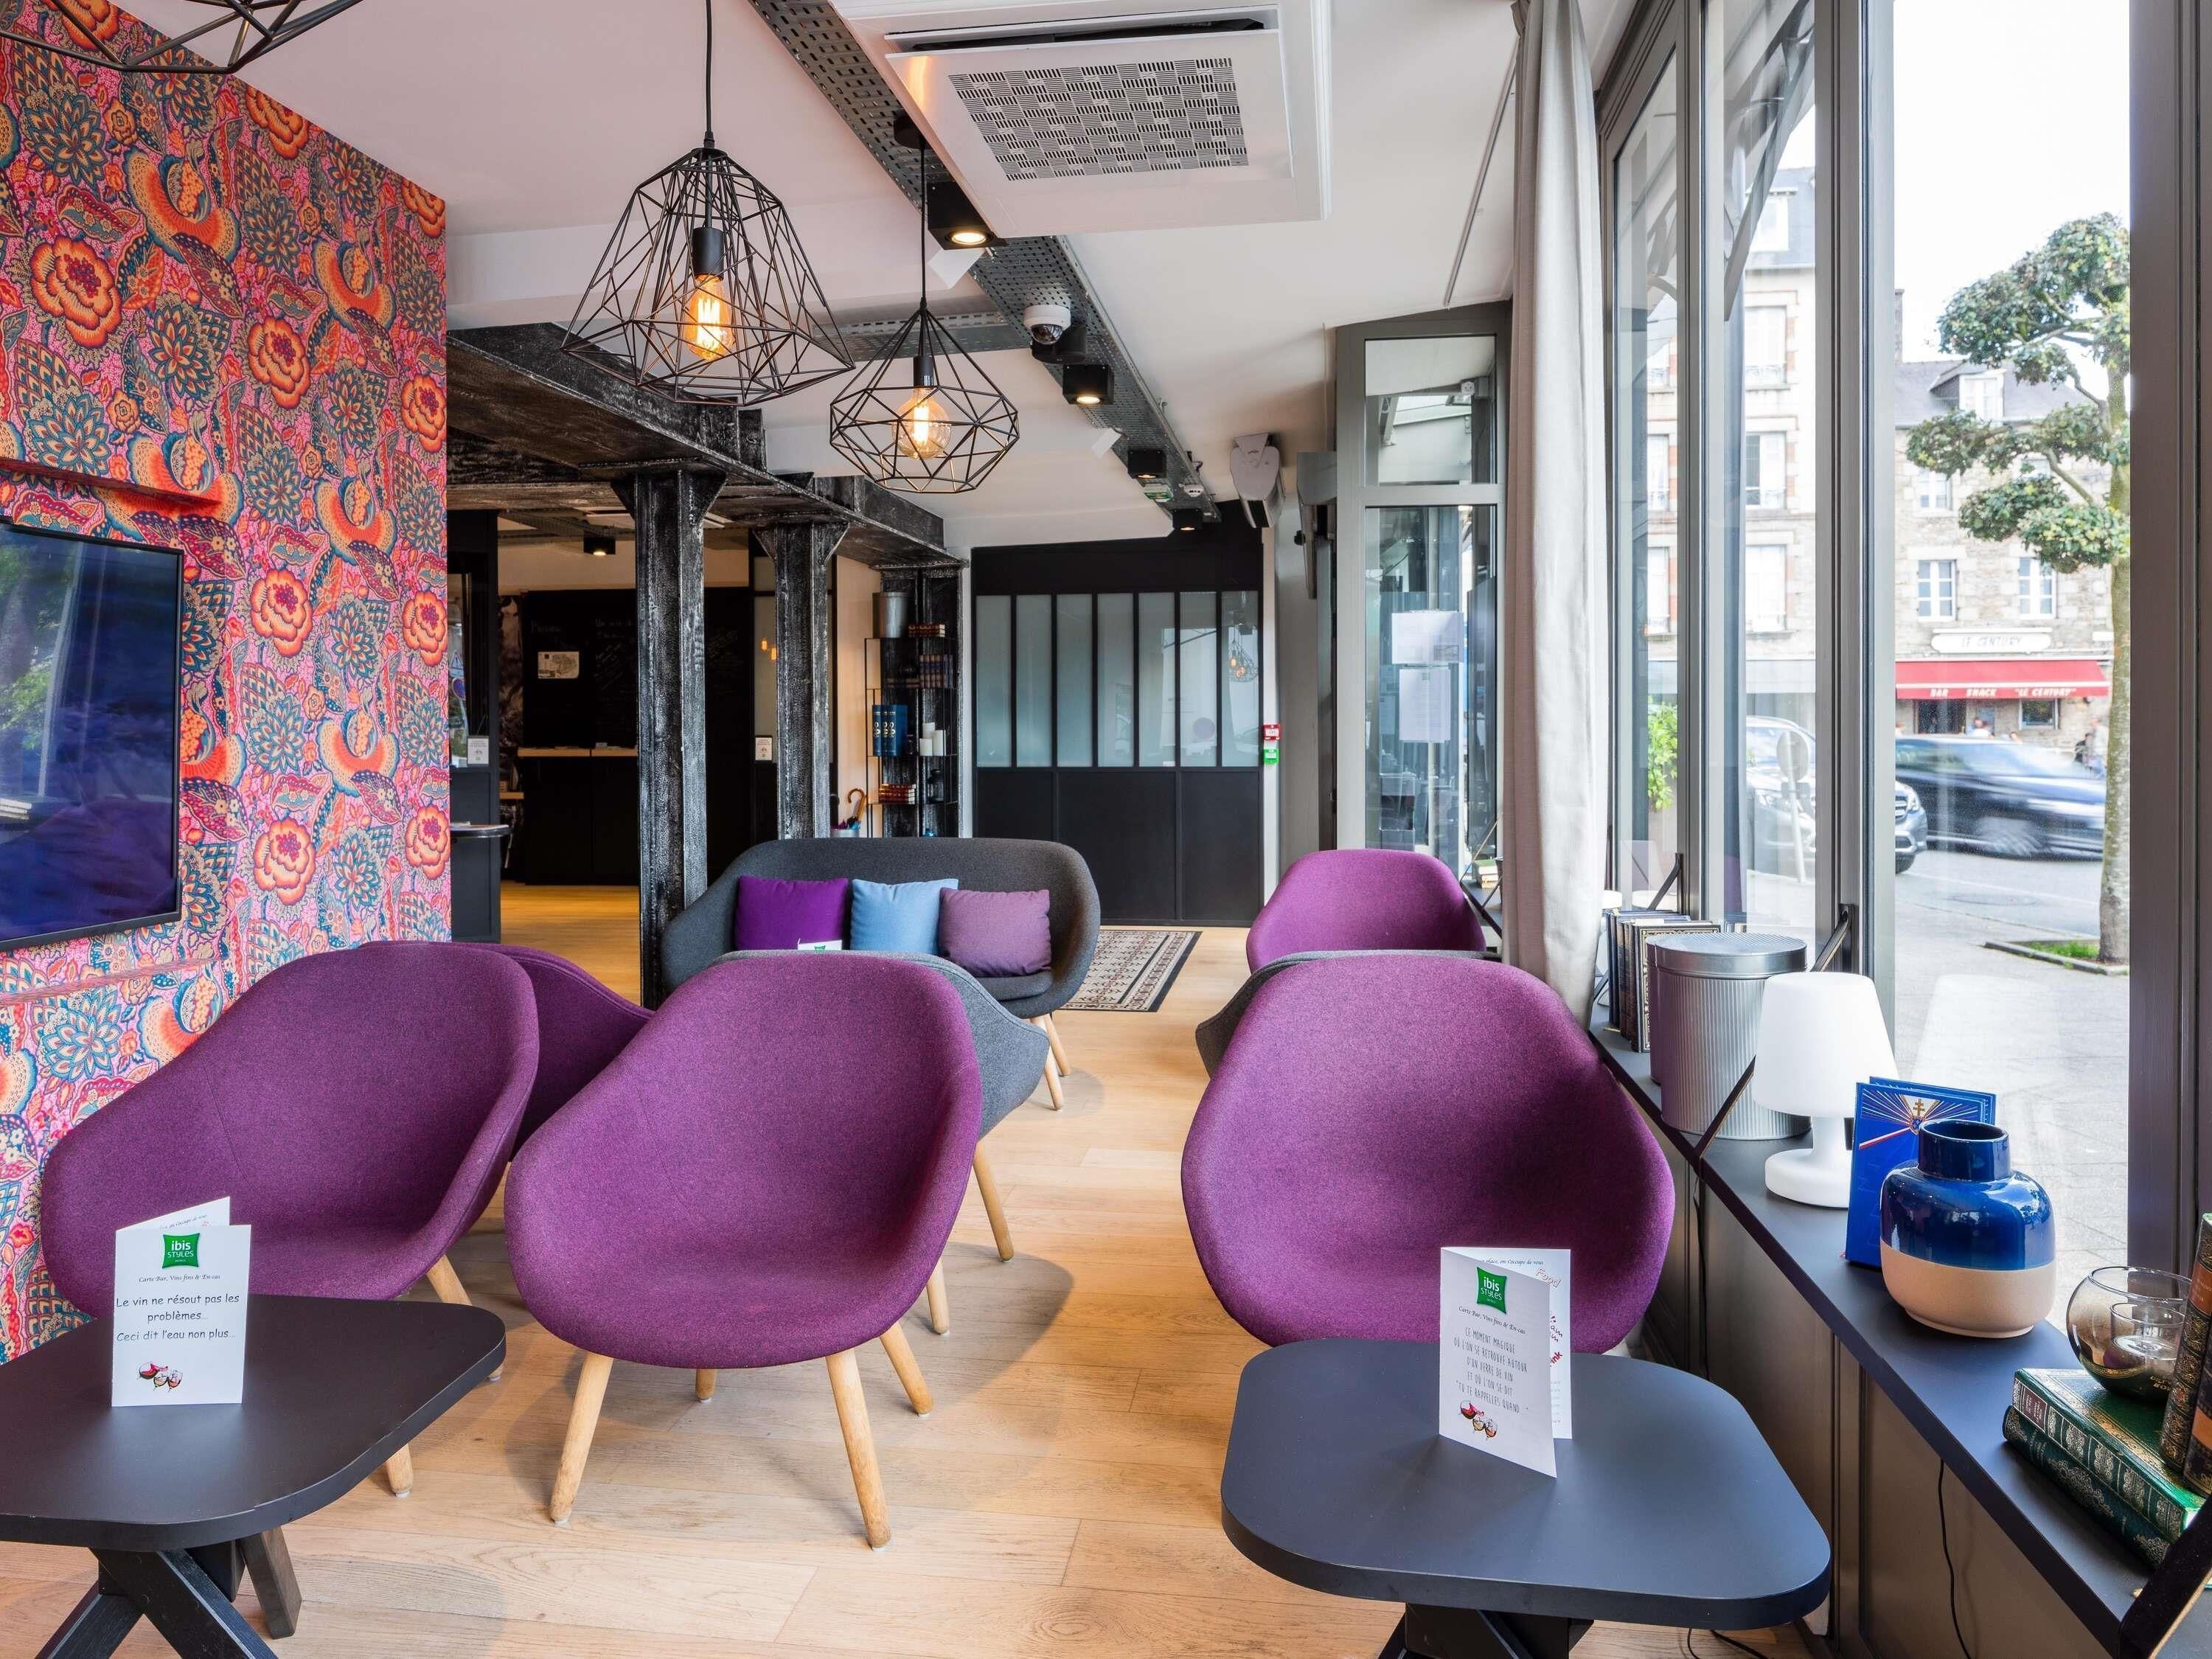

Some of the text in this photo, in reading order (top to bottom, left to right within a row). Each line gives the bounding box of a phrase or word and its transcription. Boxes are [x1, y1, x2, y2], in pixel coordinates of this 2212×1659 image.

[1977, 636, 2022, 647] CENTURY
[1930, 688, 1949, 697] BAR
[171, 1240, 191, 1251] ibis
[1484, 1276, 1500, 1292] ibis
[116, 1293, 240, 1307] Le vin ne résout pas les
[116, 1331, 139, 1341] Ceci
[143, 1330, 159, 1340] dit
[162, 1329, 184, 1339] l'eau
[188, 1330, 206, 1339] non
[1472, 1330, 1491, 1344] MOMENT
[1493, 1337, 1515, 1354] MAGIQUE
[1474, 1345, 1480, 1355] SE
[1482, 1348, 1505, 1366] RETROUVE
[1507, 1357, 1528, 1373] AUTOUR
[1550, 1351, 1563, 1364] ink
[1481, 1362, 1494, 1375] VERRE
[1496, 1368, 1502, 1379] DE
[1467, 1371, 1472, 1380] ET
[1496, 1382, 1502, 1392] SE
[1504, 1385, 1512, 1397] DIT
[1467, 1385, 1472, 1396] TE
[1475, 1388, 1500, 1407] RAPPELLES
